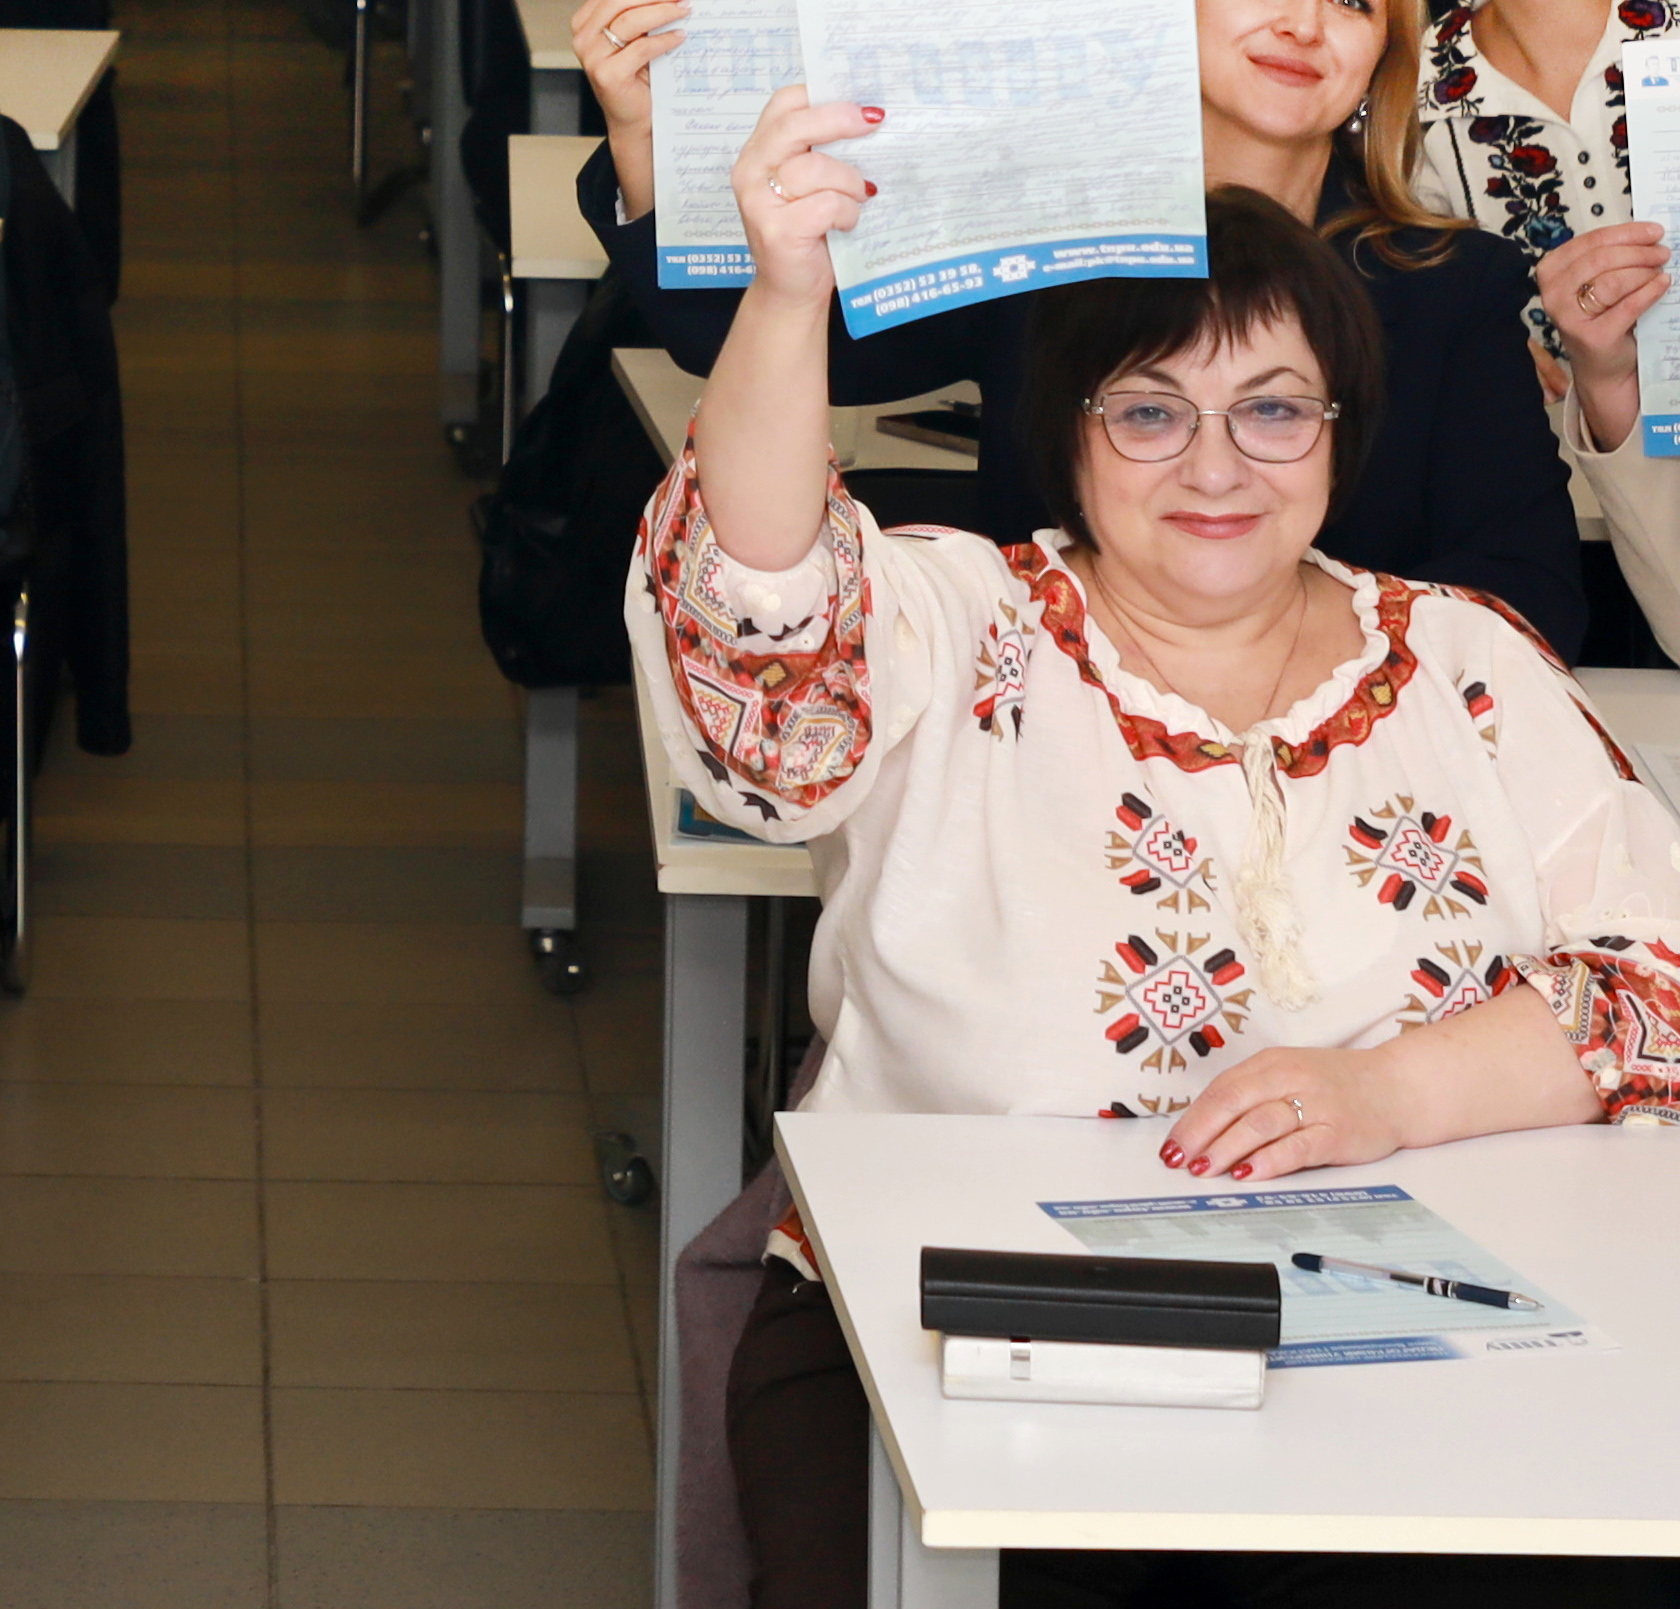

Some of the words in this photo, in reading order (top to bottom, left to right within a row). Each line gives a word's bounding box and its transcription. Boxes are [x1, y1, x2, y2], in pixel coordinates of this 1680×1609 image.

[827, 23, 1172, 114] ТНПУ
[687, 253, 725, 265] (0352)
[727, 253, 741, 263] 53
[687, 265, 718, 276] (098)
[850, 295, 872, 309] тел
[873, 275, 917, 302] (0352)
[918, 272, 936, 286] 53
[938, 267, 957, 282] 39
[959, 262, 983, 278] 58,
[875, 296, 909, 317] (098)
[912, 277, 984, 303] 416-65-93
[1652, 425, 1673, 433] тел
